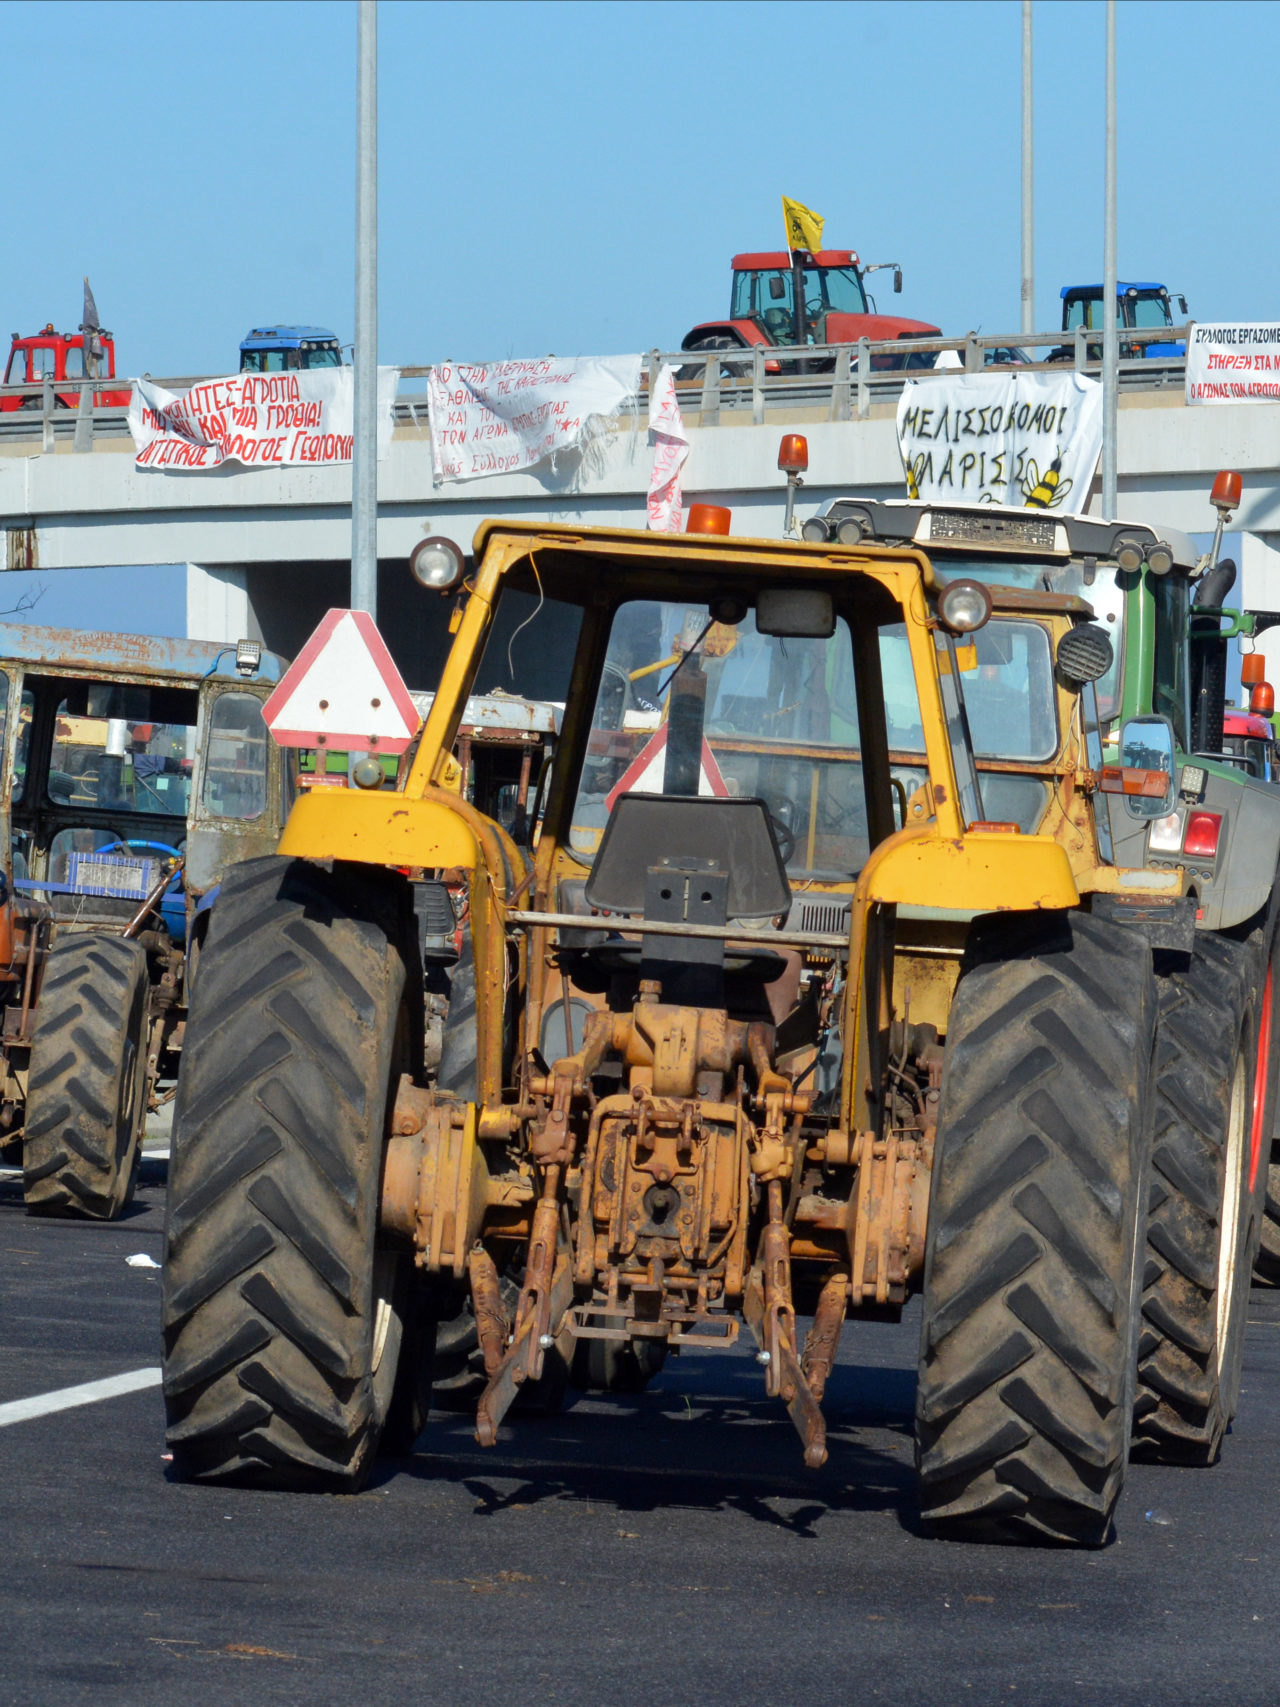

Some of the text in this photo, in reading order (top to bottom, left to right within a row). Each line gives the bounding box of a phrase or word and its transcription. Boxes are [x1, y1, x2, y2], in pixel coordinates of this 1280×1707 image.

[1195, 328, 1237, 344] ΣΥΛΛΟΓΟΣ
[1207, 354, 1252, 370] ΣΤΗΡΙΞΗ
[1253, 354, 1272, 370] ΣΤΑ
[198, 411, 227, 441] ΚΑΙ
[267, 400, 322, 431] ΓΡΟΘΙΑ!
[901, 401, 1068, 443] ΜΕΛΙΣΣΟΚΟΜΟΙ
[290, 430, 354, 462] ΓΕΩΠΟΝΙ
